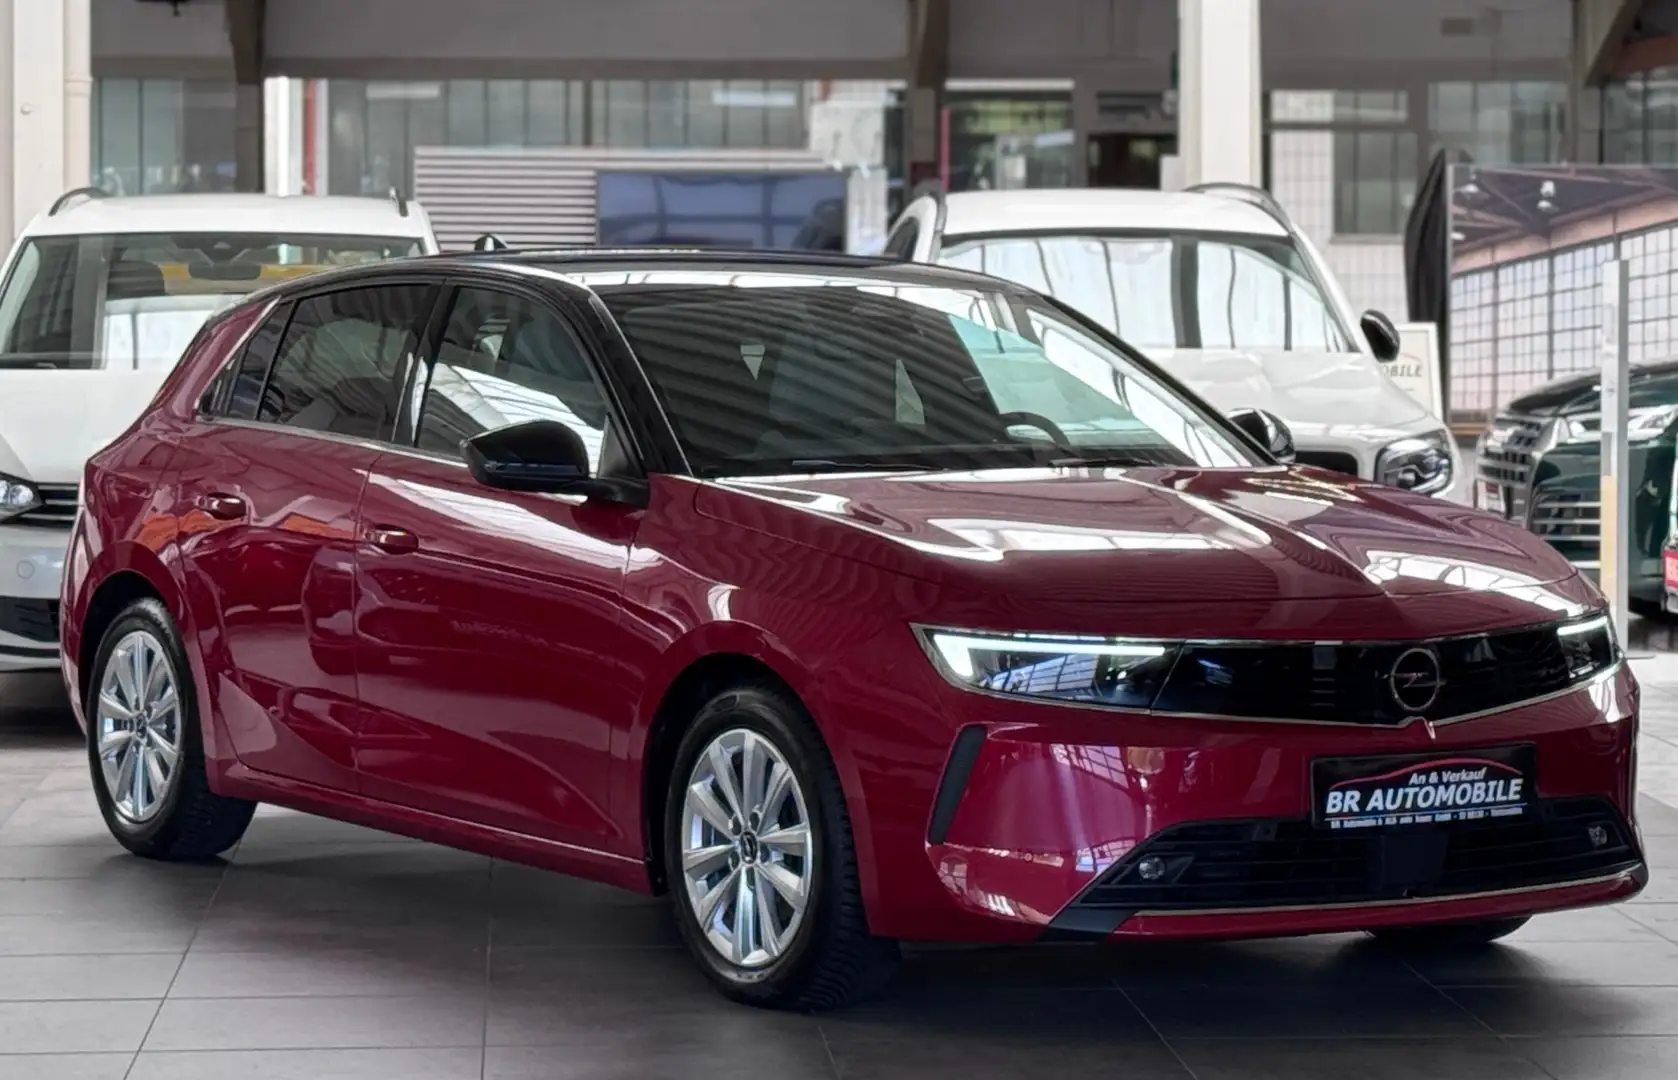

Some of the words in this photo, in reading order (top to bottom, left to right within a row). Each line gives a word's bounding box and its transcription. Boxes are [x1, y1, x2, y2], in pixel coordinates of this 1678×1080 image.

[1409, 772, 1426, 786] An
[1429, 771, 1439, 784] &
[1441, 766, 1488, 783] Verkauf
[1325, 790, 1361, 814] BR
[1365, 778, 1524, 812] AUTOMOBILE
